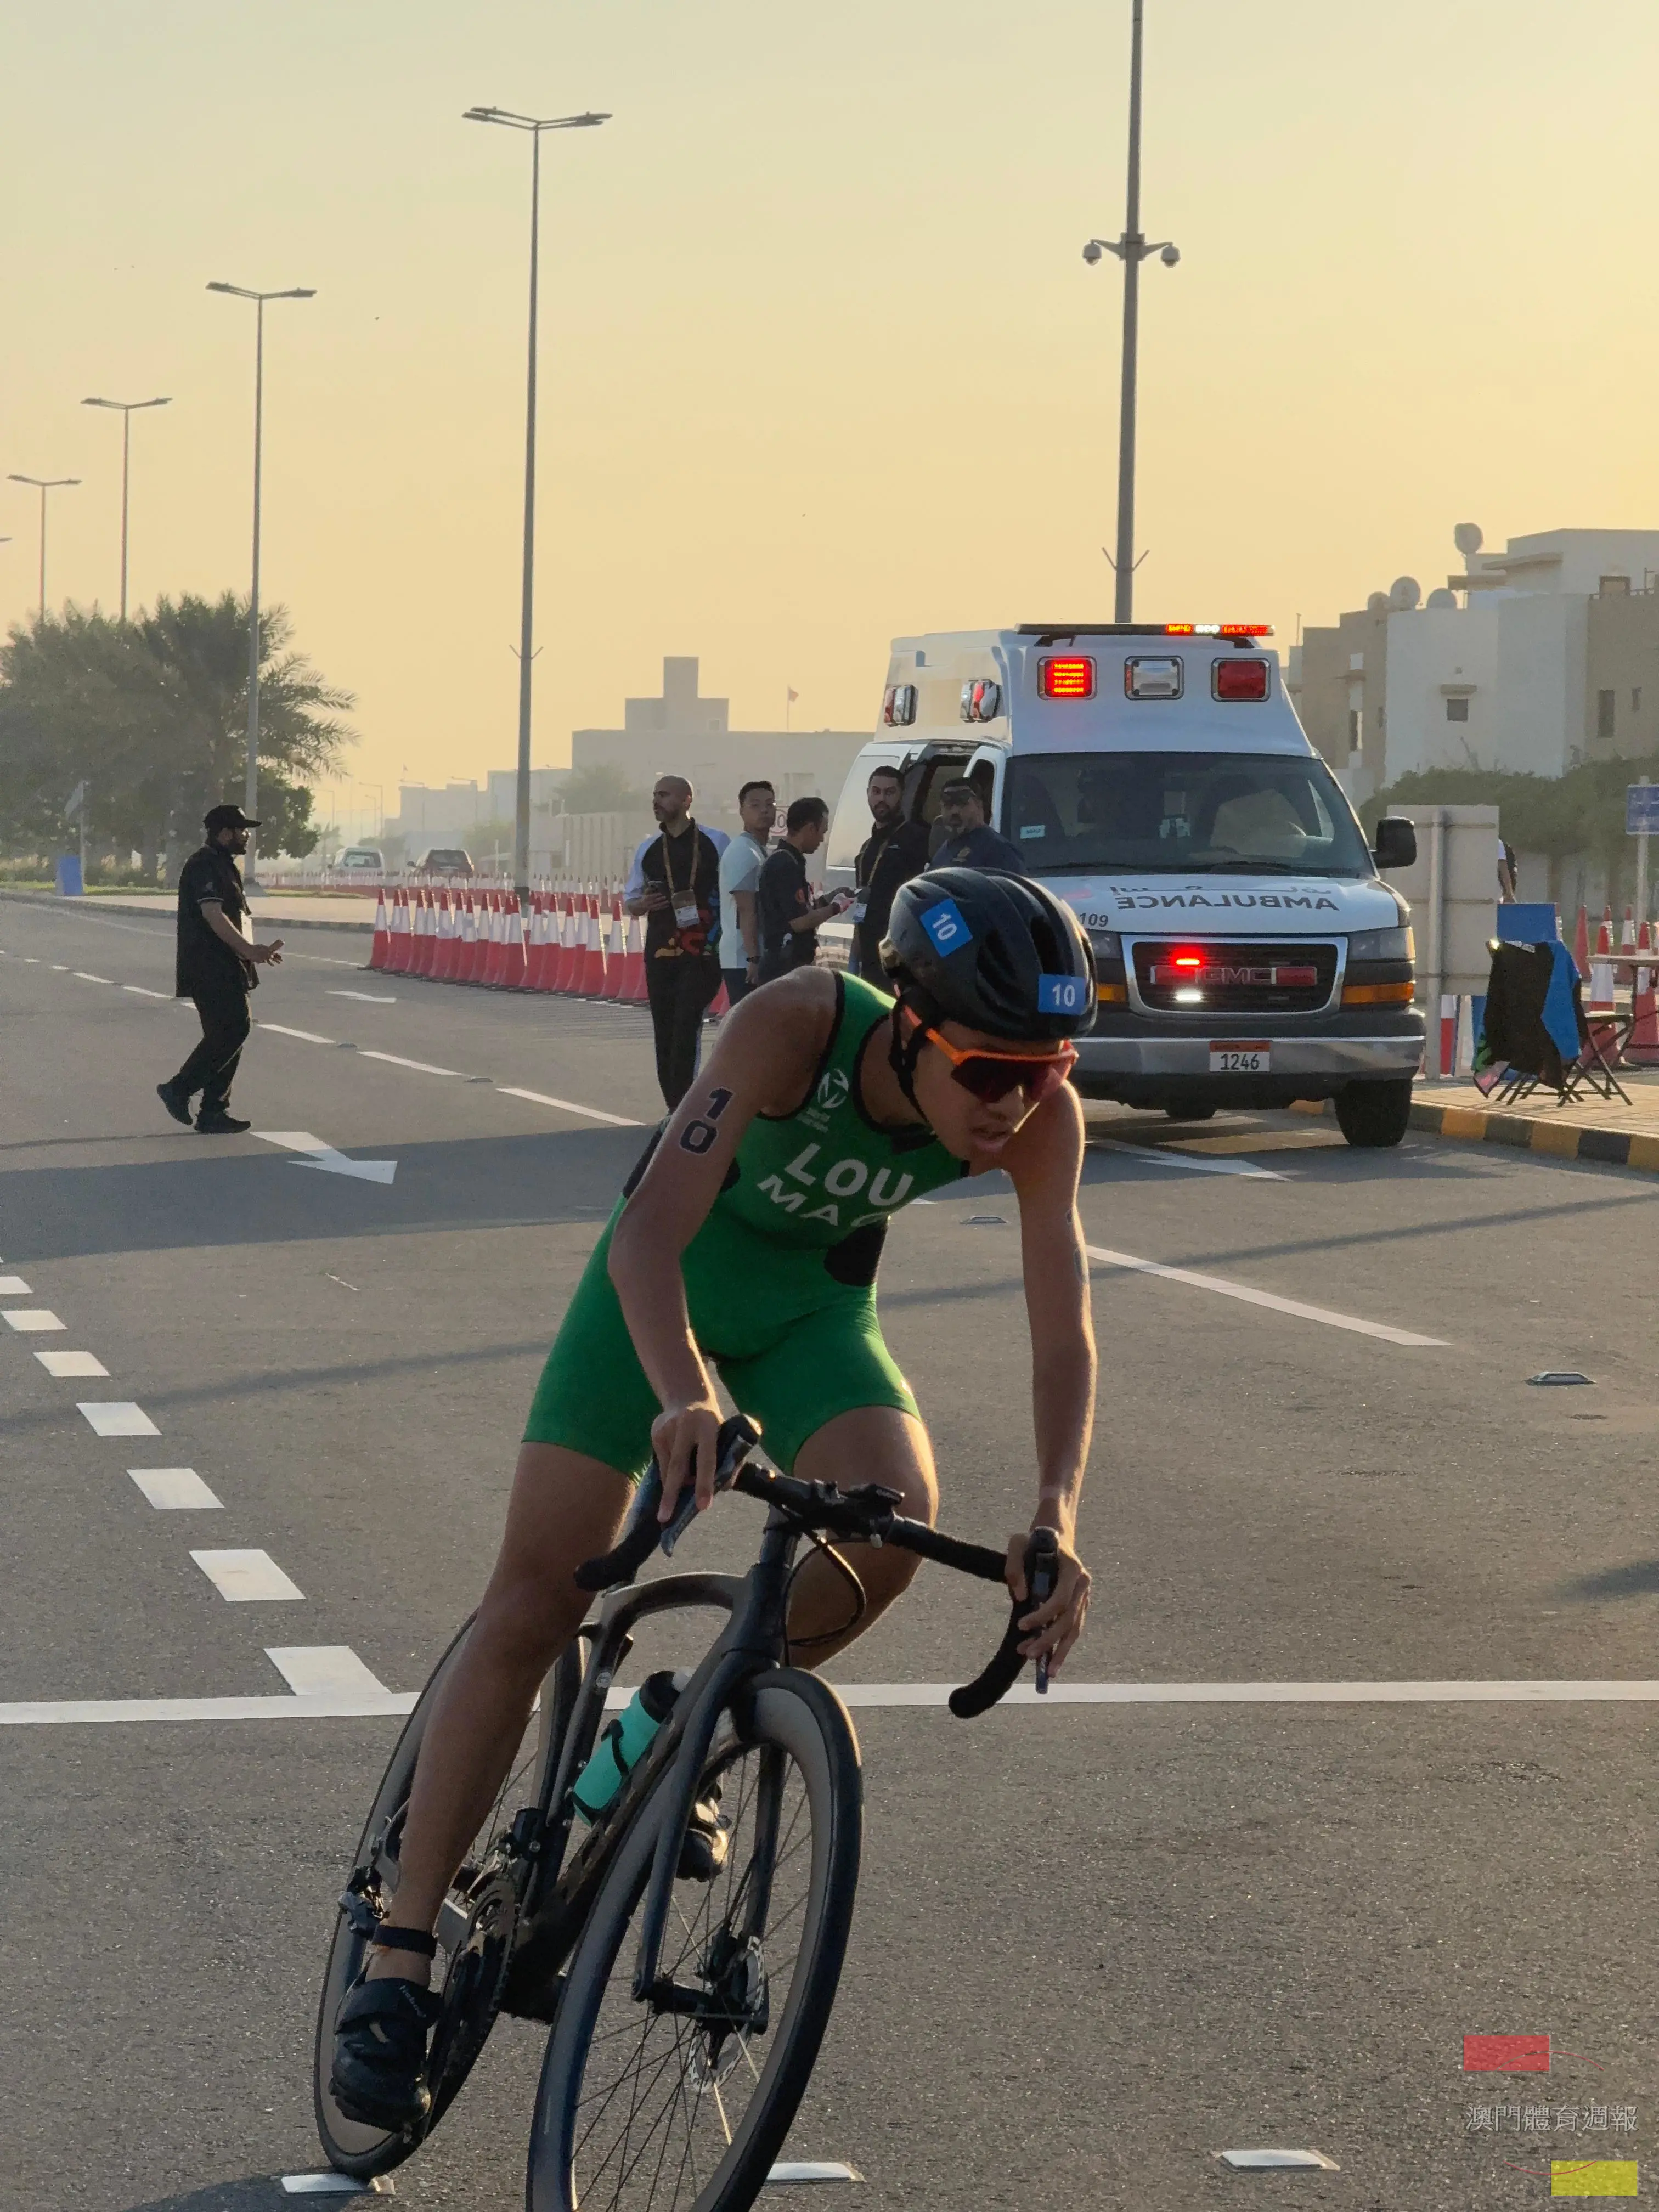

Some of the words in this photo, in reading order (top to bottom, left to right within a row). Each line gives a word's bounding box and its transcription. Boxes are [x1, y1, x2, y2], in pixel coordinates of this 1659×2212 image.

[933, 913, 957, 940] 10
[1199, 967, 1272, 985] GMC
[1052, 984, 1076, 1007] 10
[1220, 1053, 1260, 1070] 1246
[679, 1087, 734, 1154] 10
[784, 1143, 914, 1206] LOU
